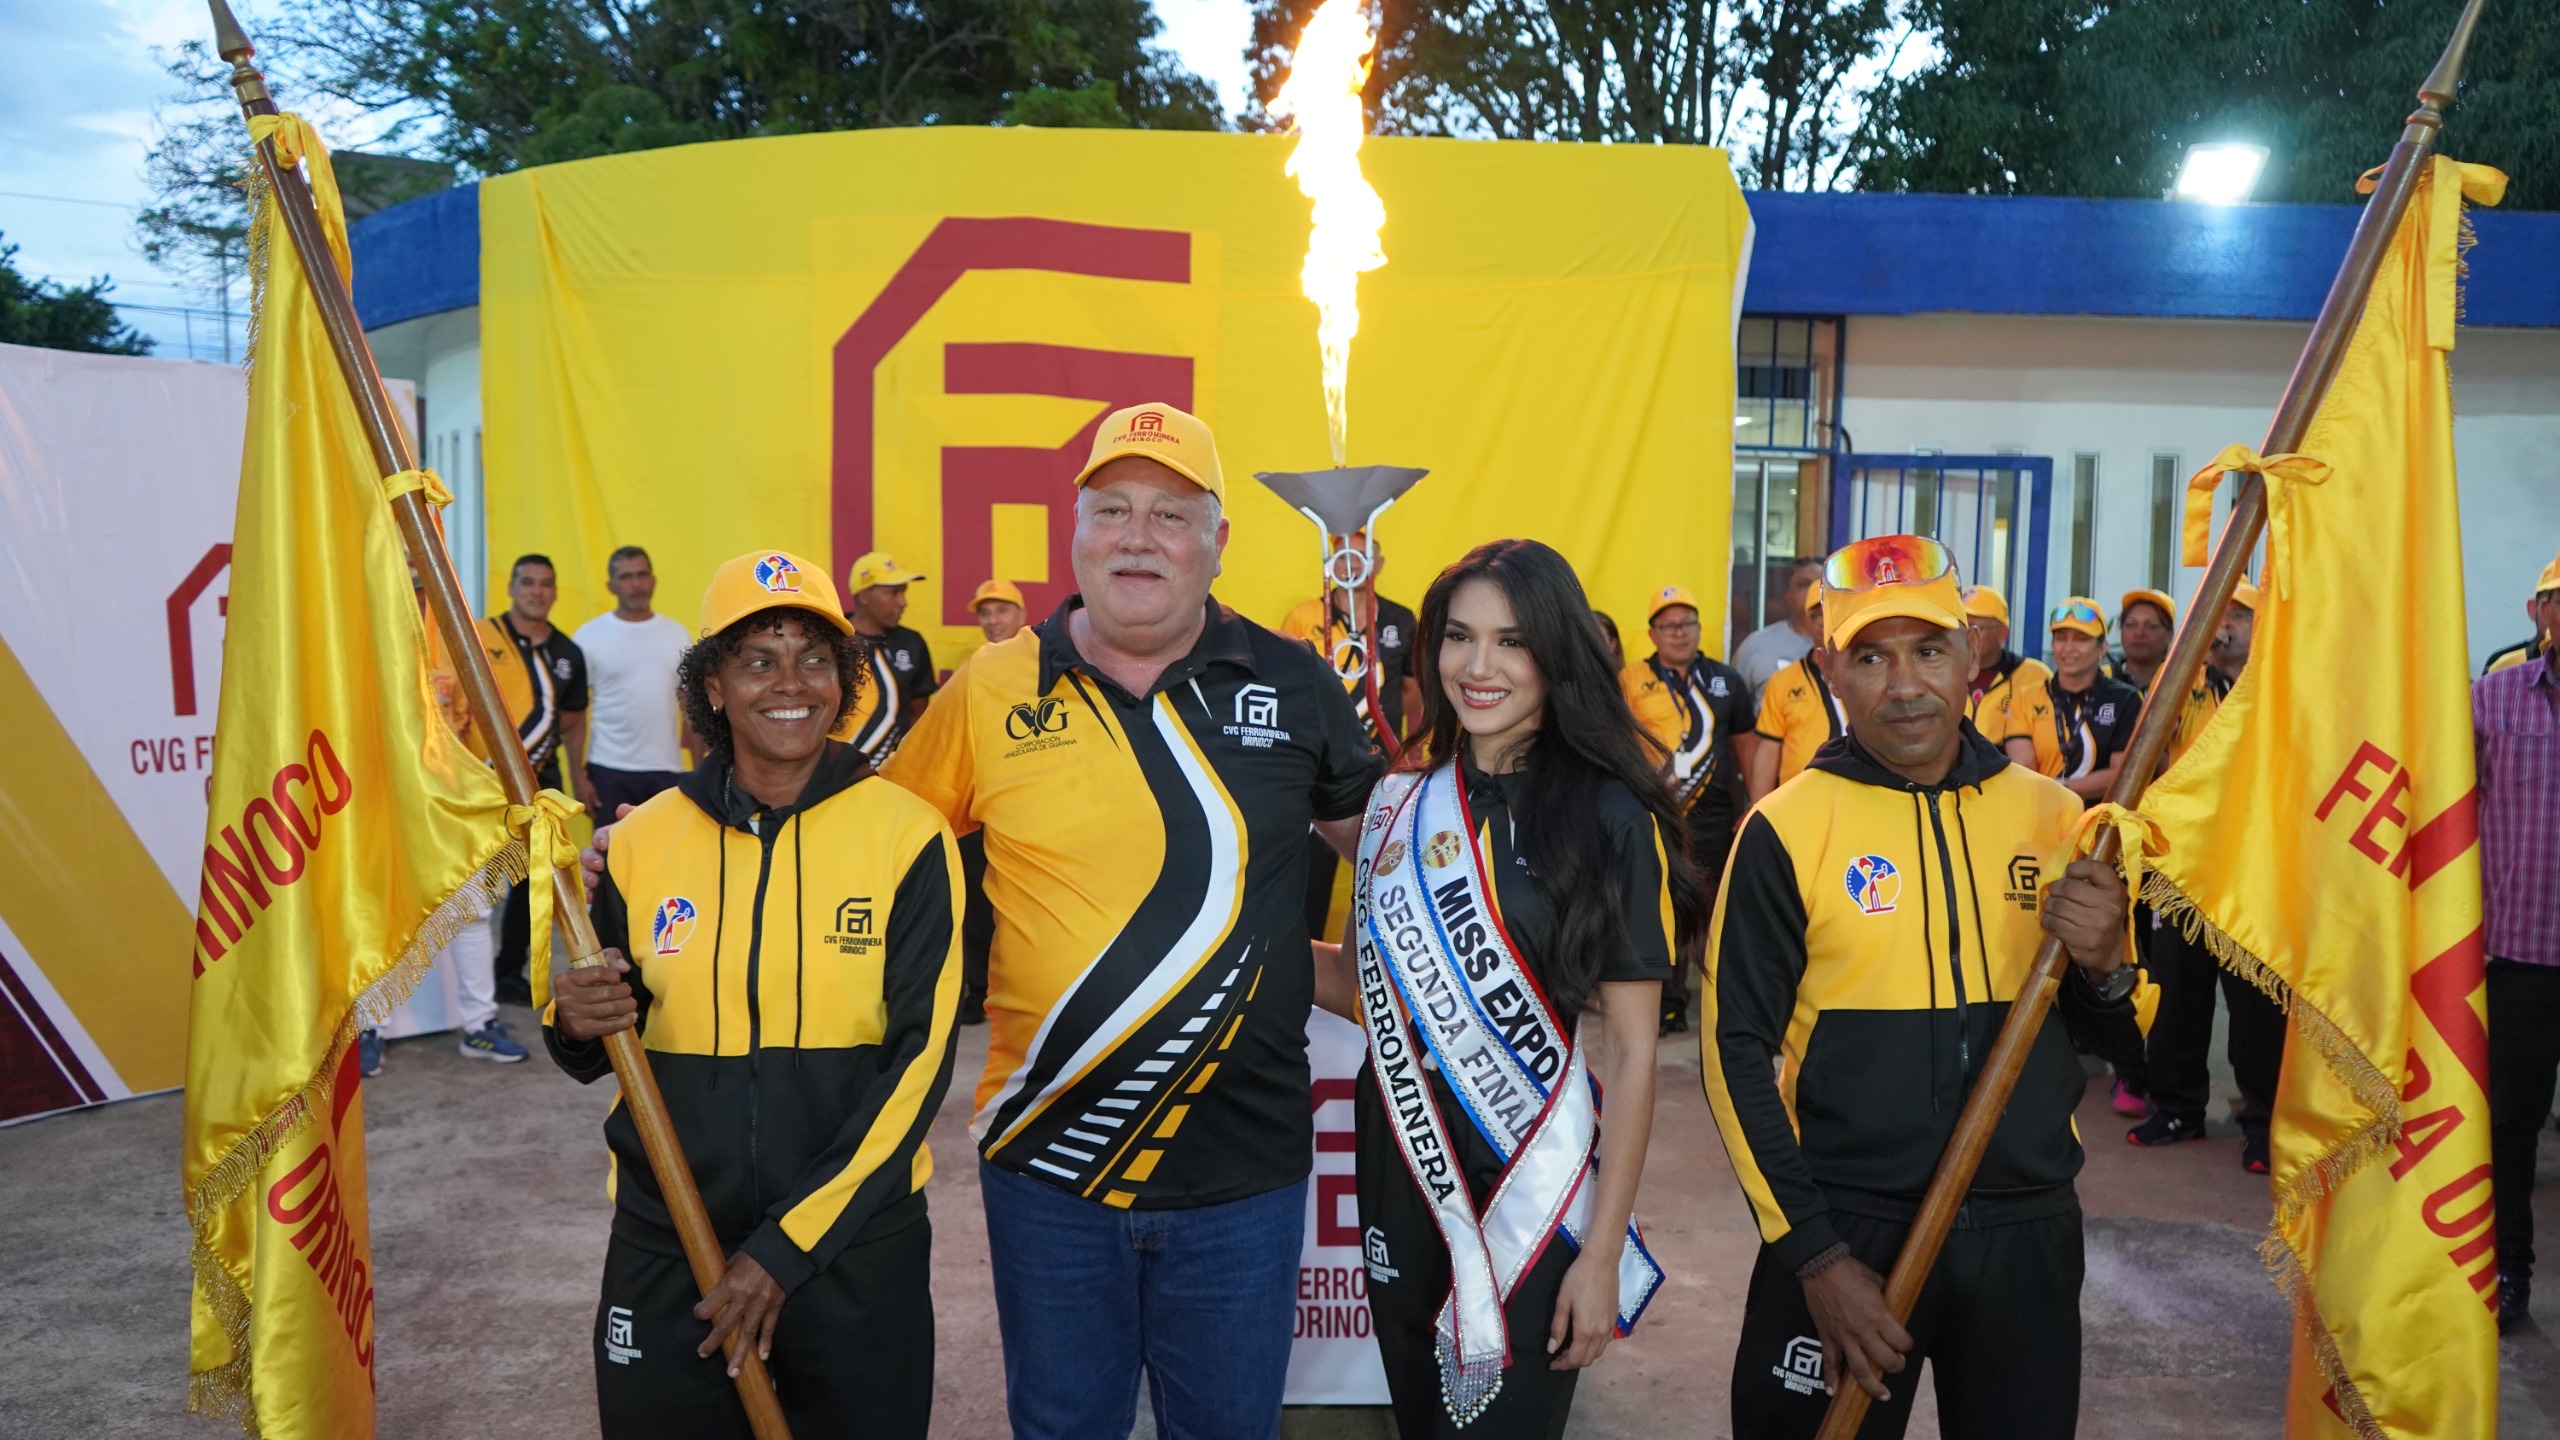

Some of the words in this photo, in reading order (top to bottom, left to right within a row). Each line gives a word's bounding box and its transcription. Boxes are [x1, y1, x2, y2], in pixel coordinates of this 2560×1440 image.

[1129, 431, 1180, 445] FERROMINERA
[1223, 726, 1239, 735] CVG
[1241, 727, 1291, 741] FERROMINERA
[1048, 739, 1077, 749] GUAYANA
[1242, 736, 1273, 748] ORINOCO
[130, 737, 186, 775] CVG
[1358, 857, 1370, 929] CVG
[824, 936, 838, 944] CVG
[839, 937, 882, 946] FERROMINERA
[839, 945, 867, 955] ORINOCO
[1380, 885, 1468, 1047] SEGUNDA
[1434, 876, 1499, 982] MISS
[1480, 979, 1560, 1083] EXPO
[1361, 940, 1456, 1204] FERROMINERA
